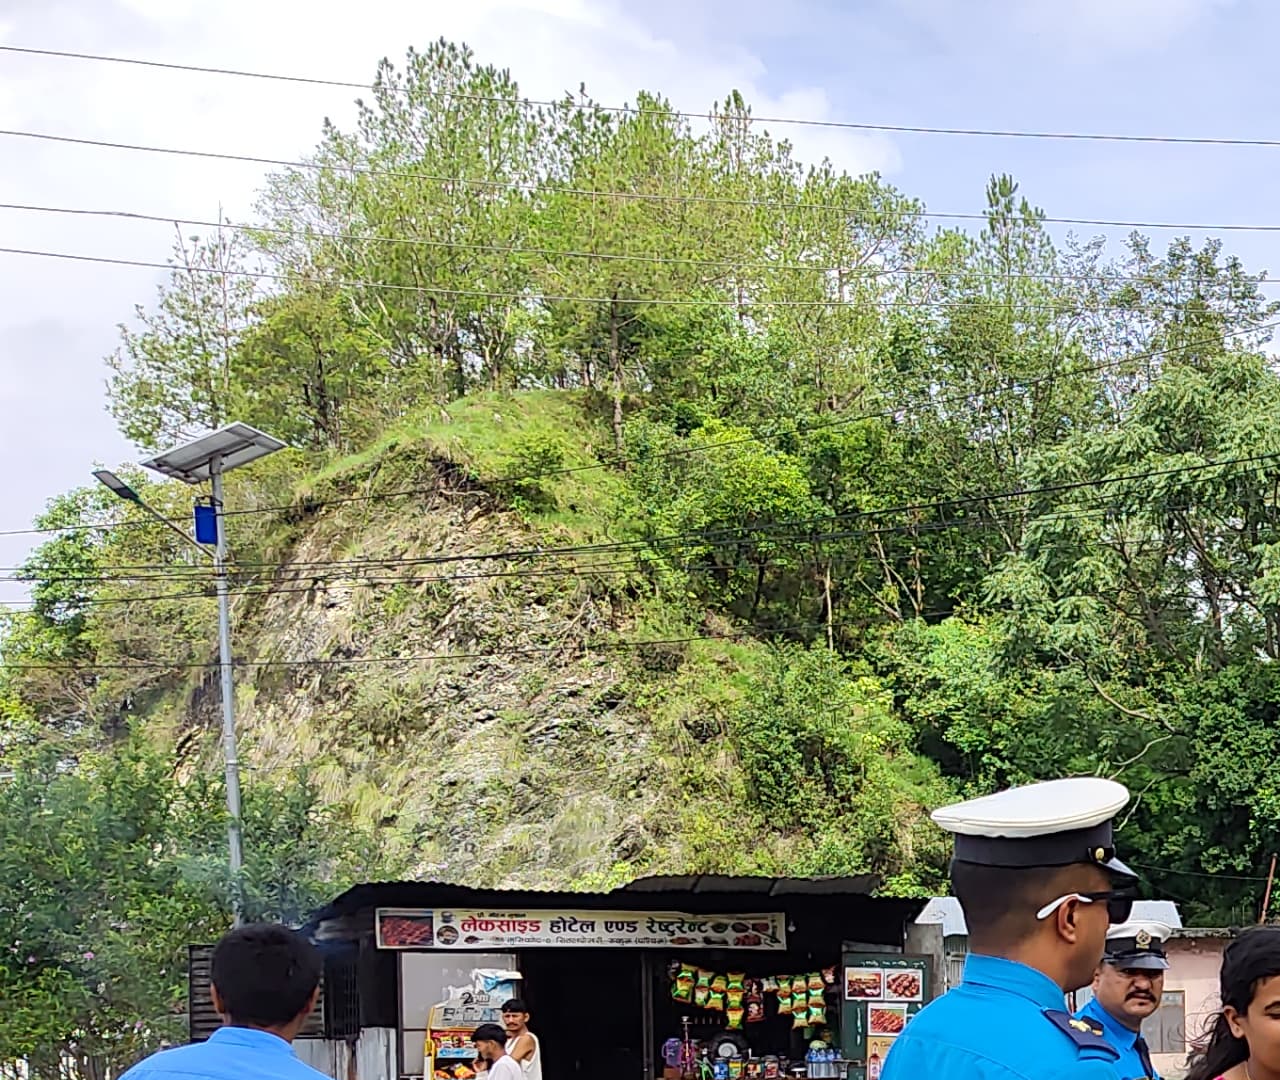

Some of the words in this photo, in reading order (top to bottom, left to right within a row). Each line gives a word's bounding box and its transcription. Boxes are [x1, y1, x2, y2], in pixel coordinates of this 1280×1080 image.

[460, 915, 542, 935] लेकसाइड
[549, 916, 596, 934] होटेल
[604, 920, 638, 933] एण्ड
